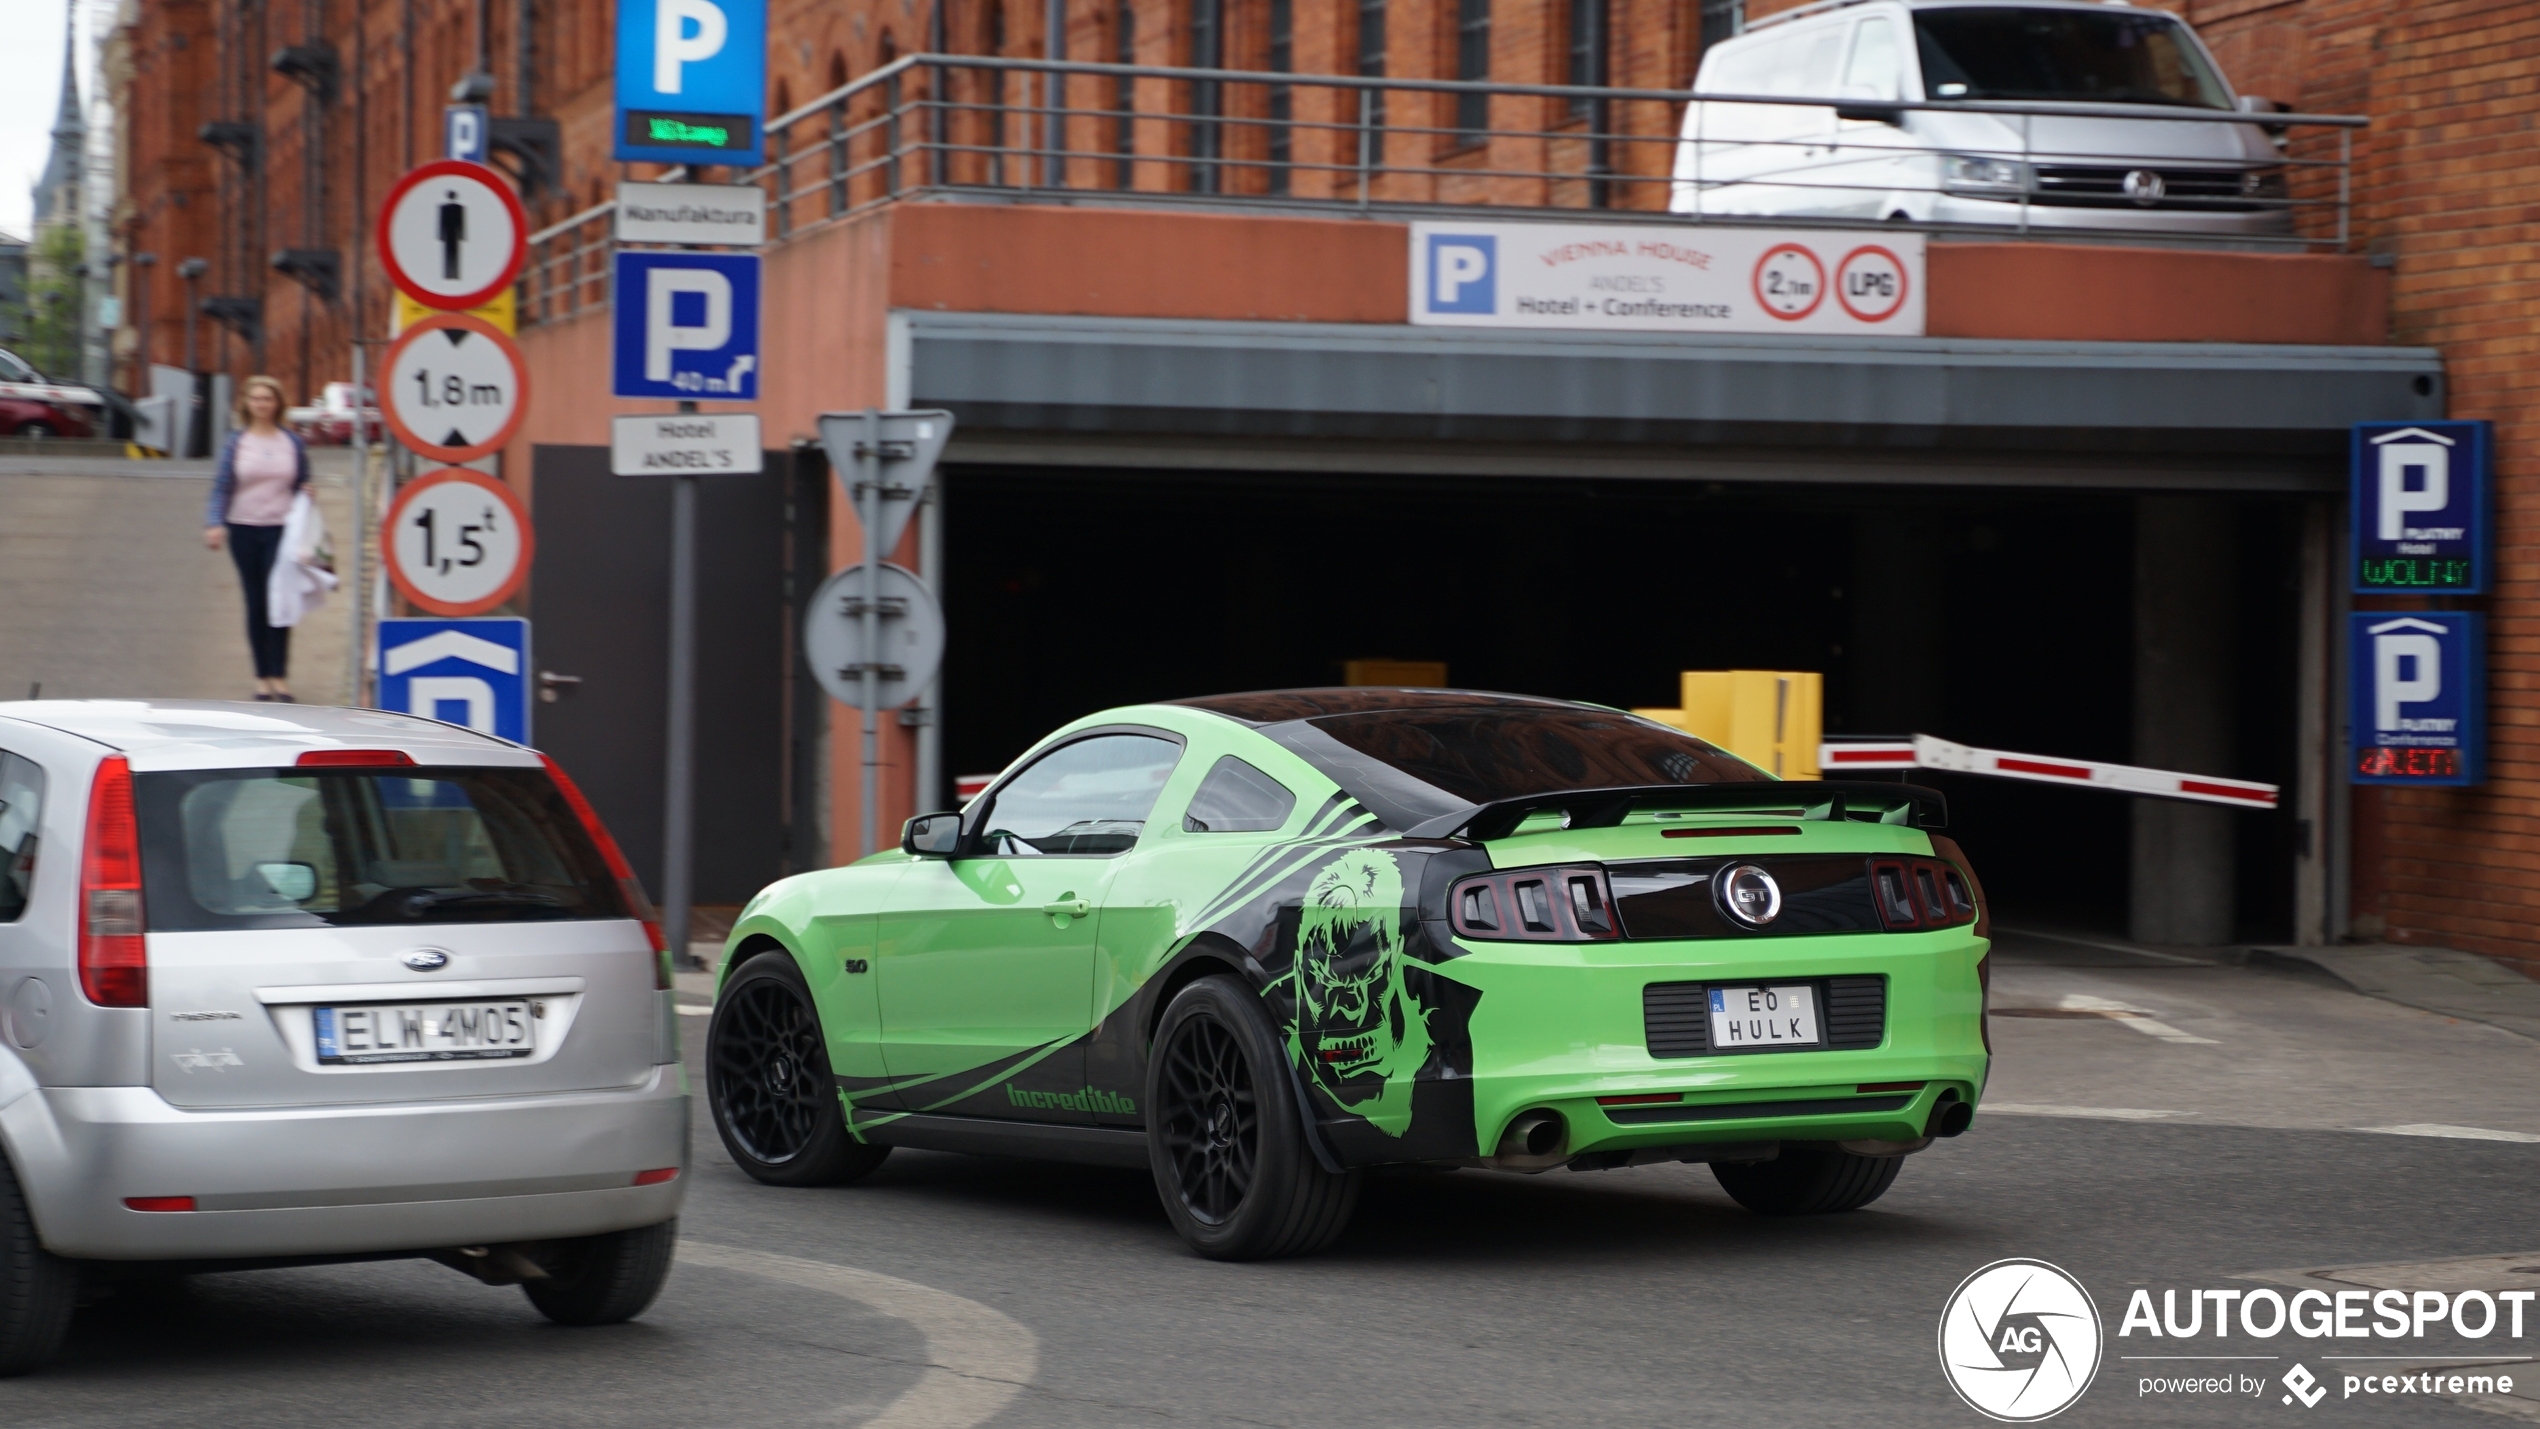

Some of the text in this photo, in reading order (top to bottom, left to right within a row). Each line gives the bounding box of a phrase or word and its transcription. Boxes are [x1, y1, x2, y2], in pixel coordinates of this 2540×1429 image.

[654, 0, 727, 94] P
[1540, 241, 1713, 270] VIENNA HOUSE
[1437, 246, 1487, 302] P
[1850, 273, 1894, 297] LPG
[1516, 296, 1579, 315] Hotel
[1602, 299, 1731, 319] Conference
[646, 267, 733, 381] P
[658, 422, 715, 438] Hotel
[2378, 443, 2449, 540] P
[2374, 634, 2441, 731] P
[1737, 889, 1769, 903] GT
[342, 1011, 424, 1050] ELW
[1729, 1018, 1802, 1041] HULK
[1005, 1083, 1137, 1115] Incredible
